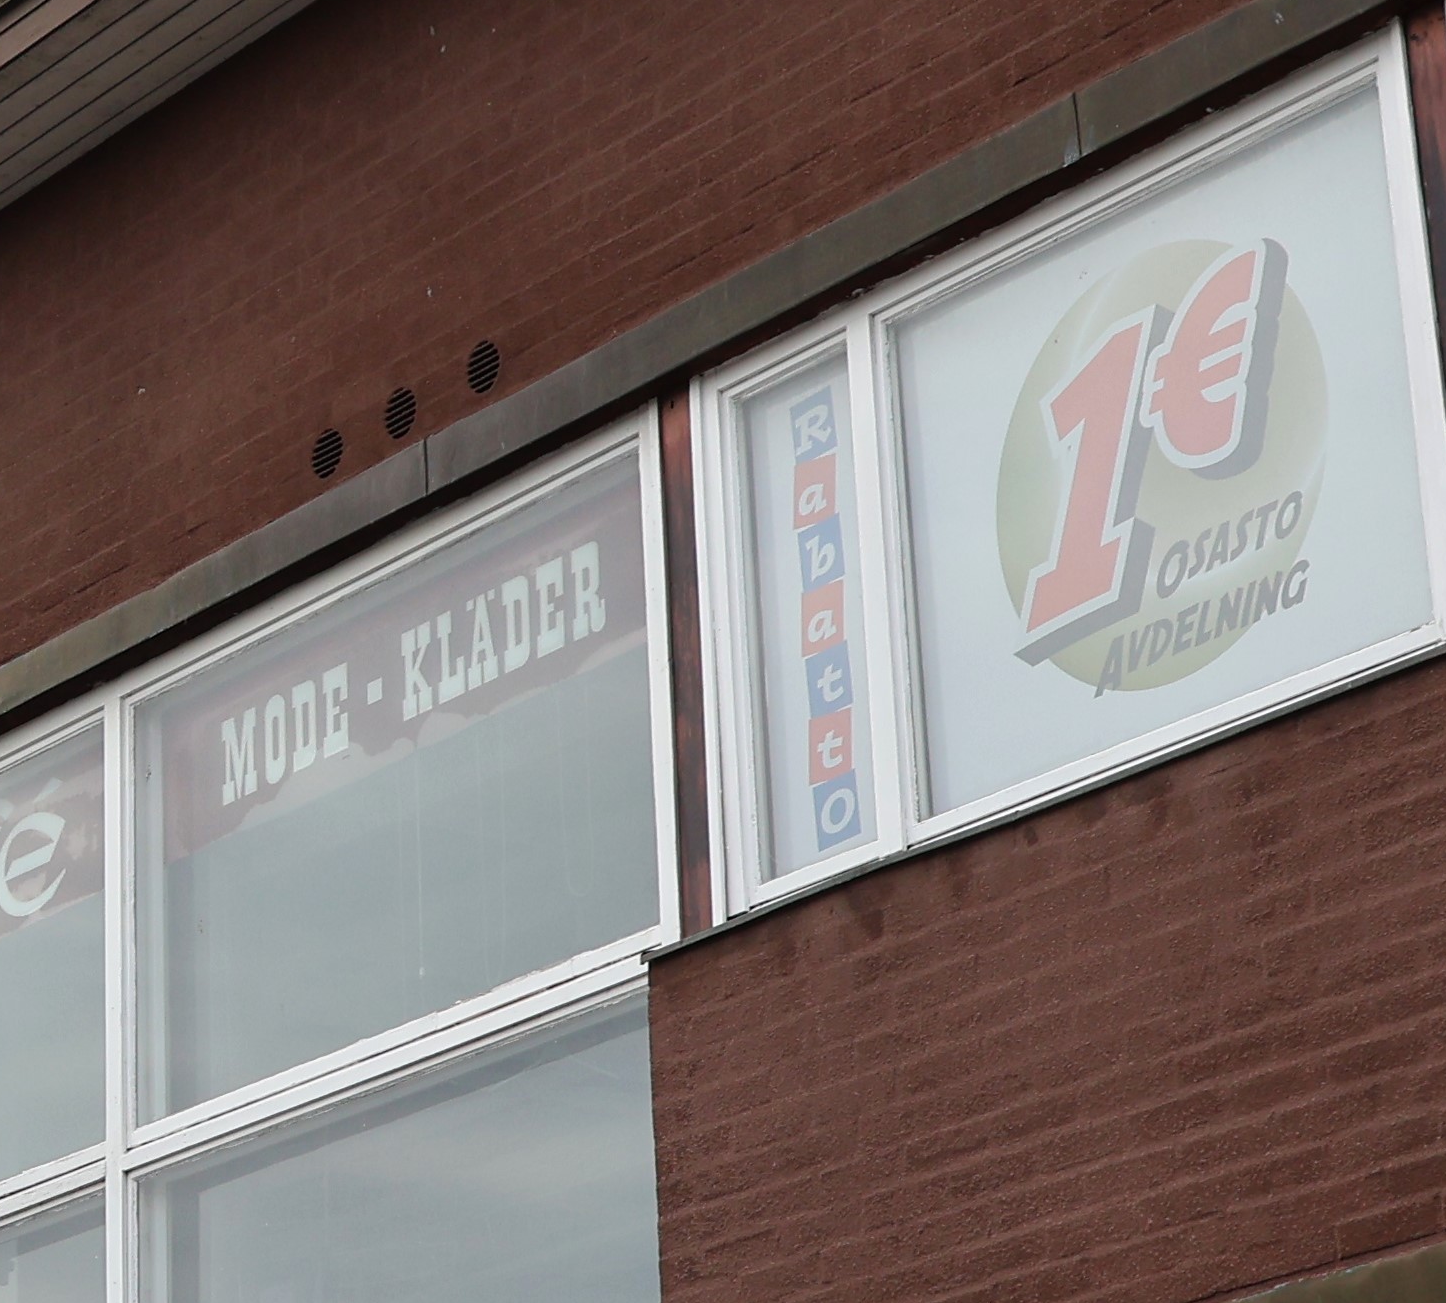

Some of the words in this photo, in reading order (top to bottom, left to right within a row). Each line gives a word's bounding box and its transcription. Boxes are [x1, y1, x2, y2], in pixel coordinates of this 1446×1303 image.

[1156, 490, 1304, 599] OSASTO
[221, 662, 349, 806] MODE
[400, 540, 607, 722] KLÄDER
[1092, 559, 1312, 699] AVDELNING
